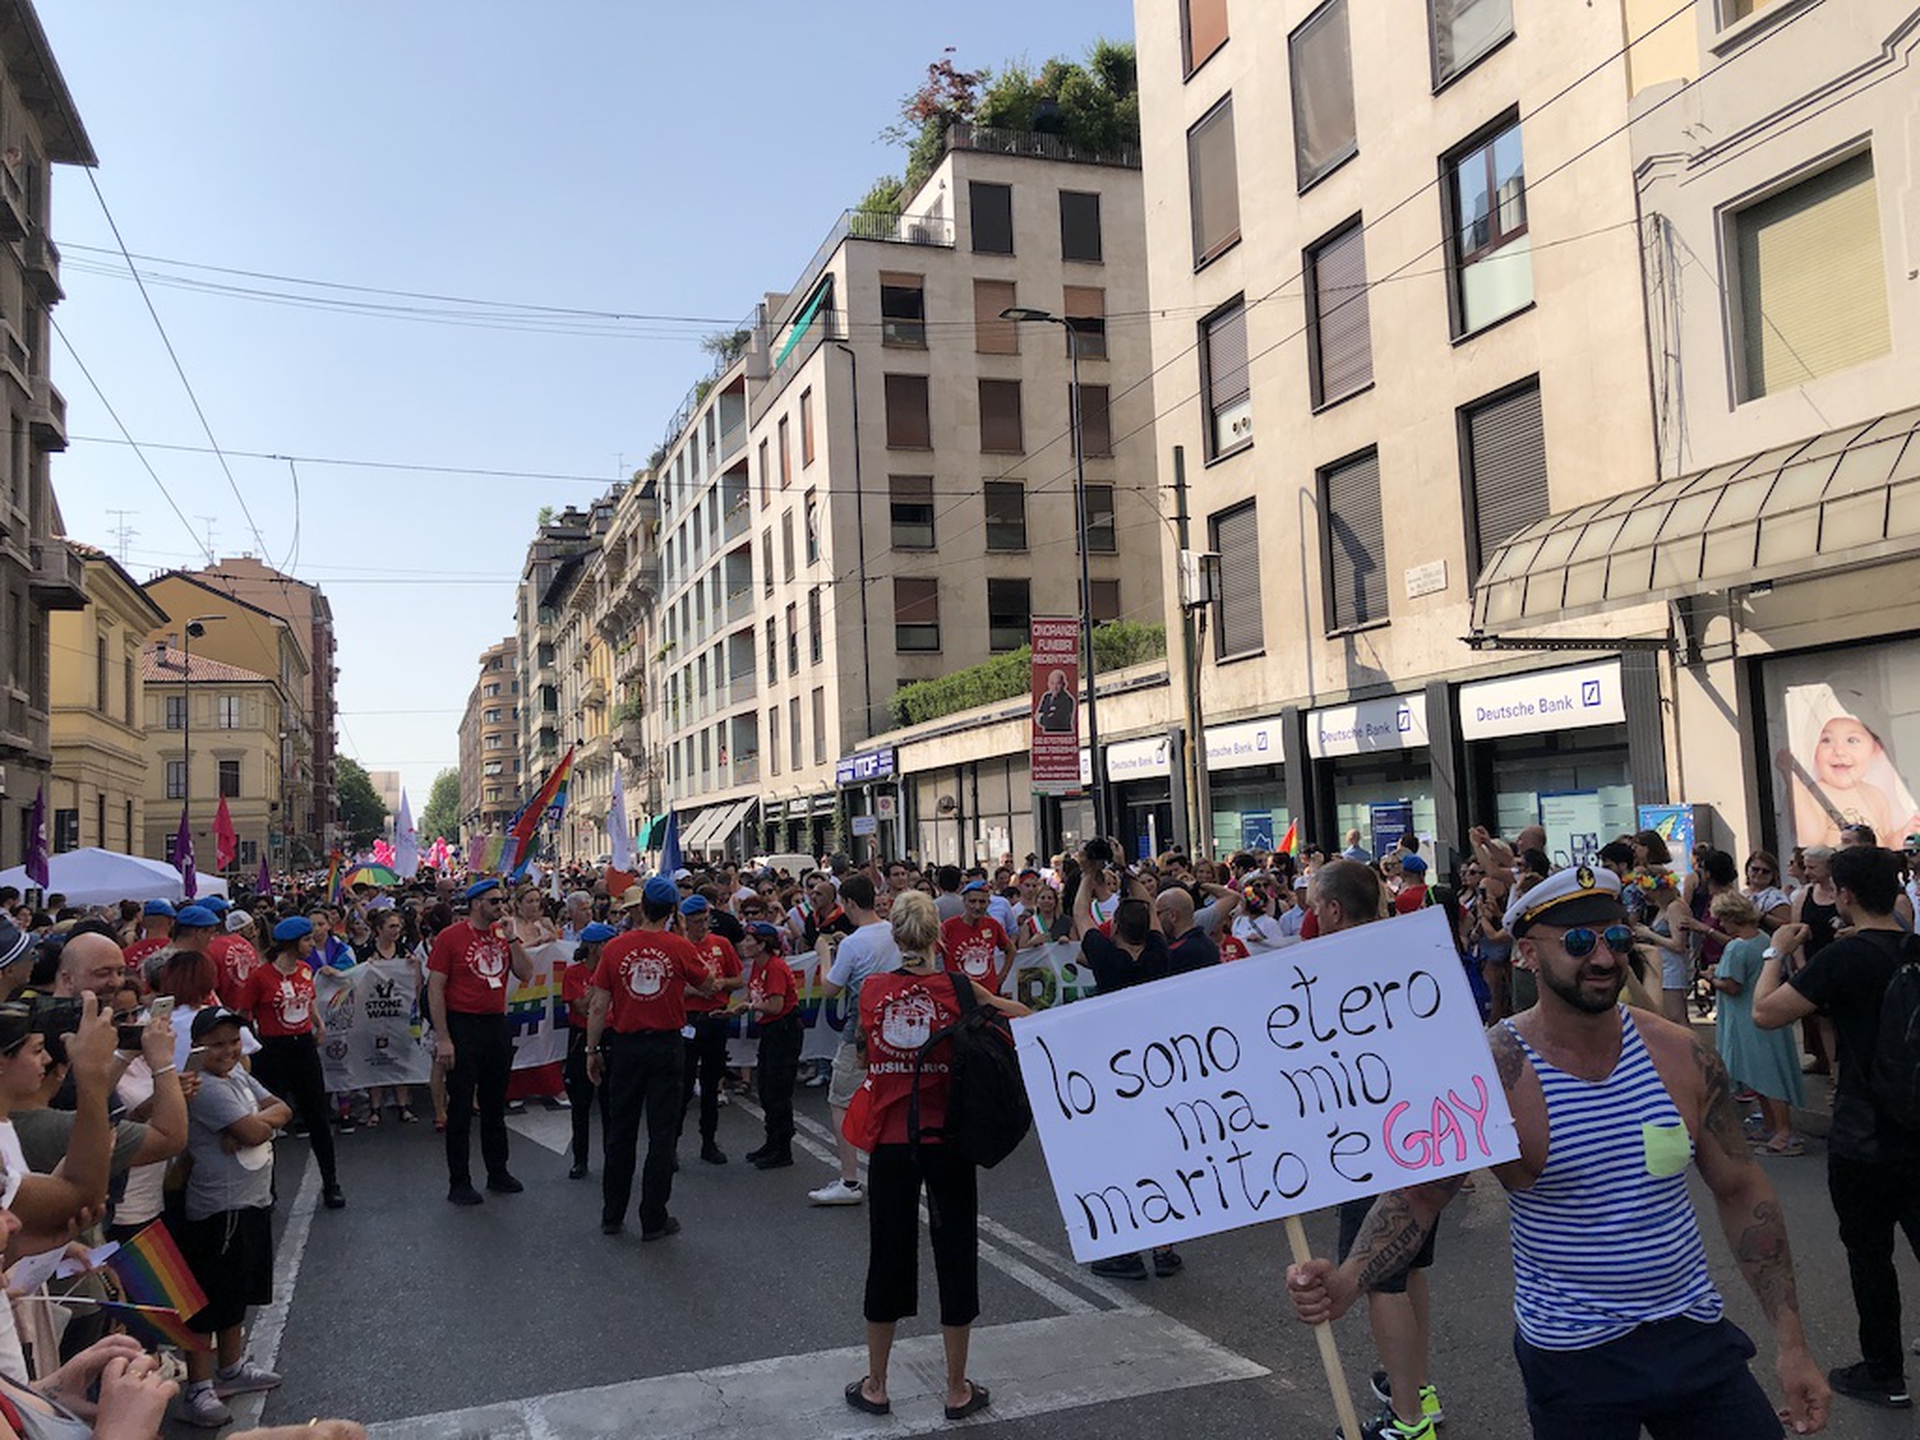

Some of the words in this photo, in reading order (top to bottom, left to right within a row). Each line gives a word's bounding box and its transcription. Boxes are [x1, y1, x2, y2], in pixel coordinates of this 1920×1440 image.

[1033, 624, 1078, 637] ONORANZE
[1038, 638, 1073, 651] FUNEBRI
[1476, 700, 1535, 722] Deutsche
[1538, 696, 1573, 714] Bank
[1320, 726, 1363, 744] Deutsche
[1366, 721, 1391, 737] Bank
[1206, 742, 1232, 758] utsche
[1233, 742, 1253, 755] Bank
[1111, 755, 1137, 771] Deutsche
[1138, 755, 1153, 768] Bank
[618, 949, 638, 975] CITY
[365, 998, 404, 1010] STONE
[367, 1009, 401, 1019] WALL
[1036, 1036, 1096, 1119] Io
[1109, 1026, 1240, 1098] sono
[1267, 965, 1441, 1049] etero
[1166, 1090, 1269, 1151] ma
[1280, 1051, 1392, 1118] mio
[1075, 1141, 1309, 1240] marito
[1383, 1075, 1491, 1170] GAY
